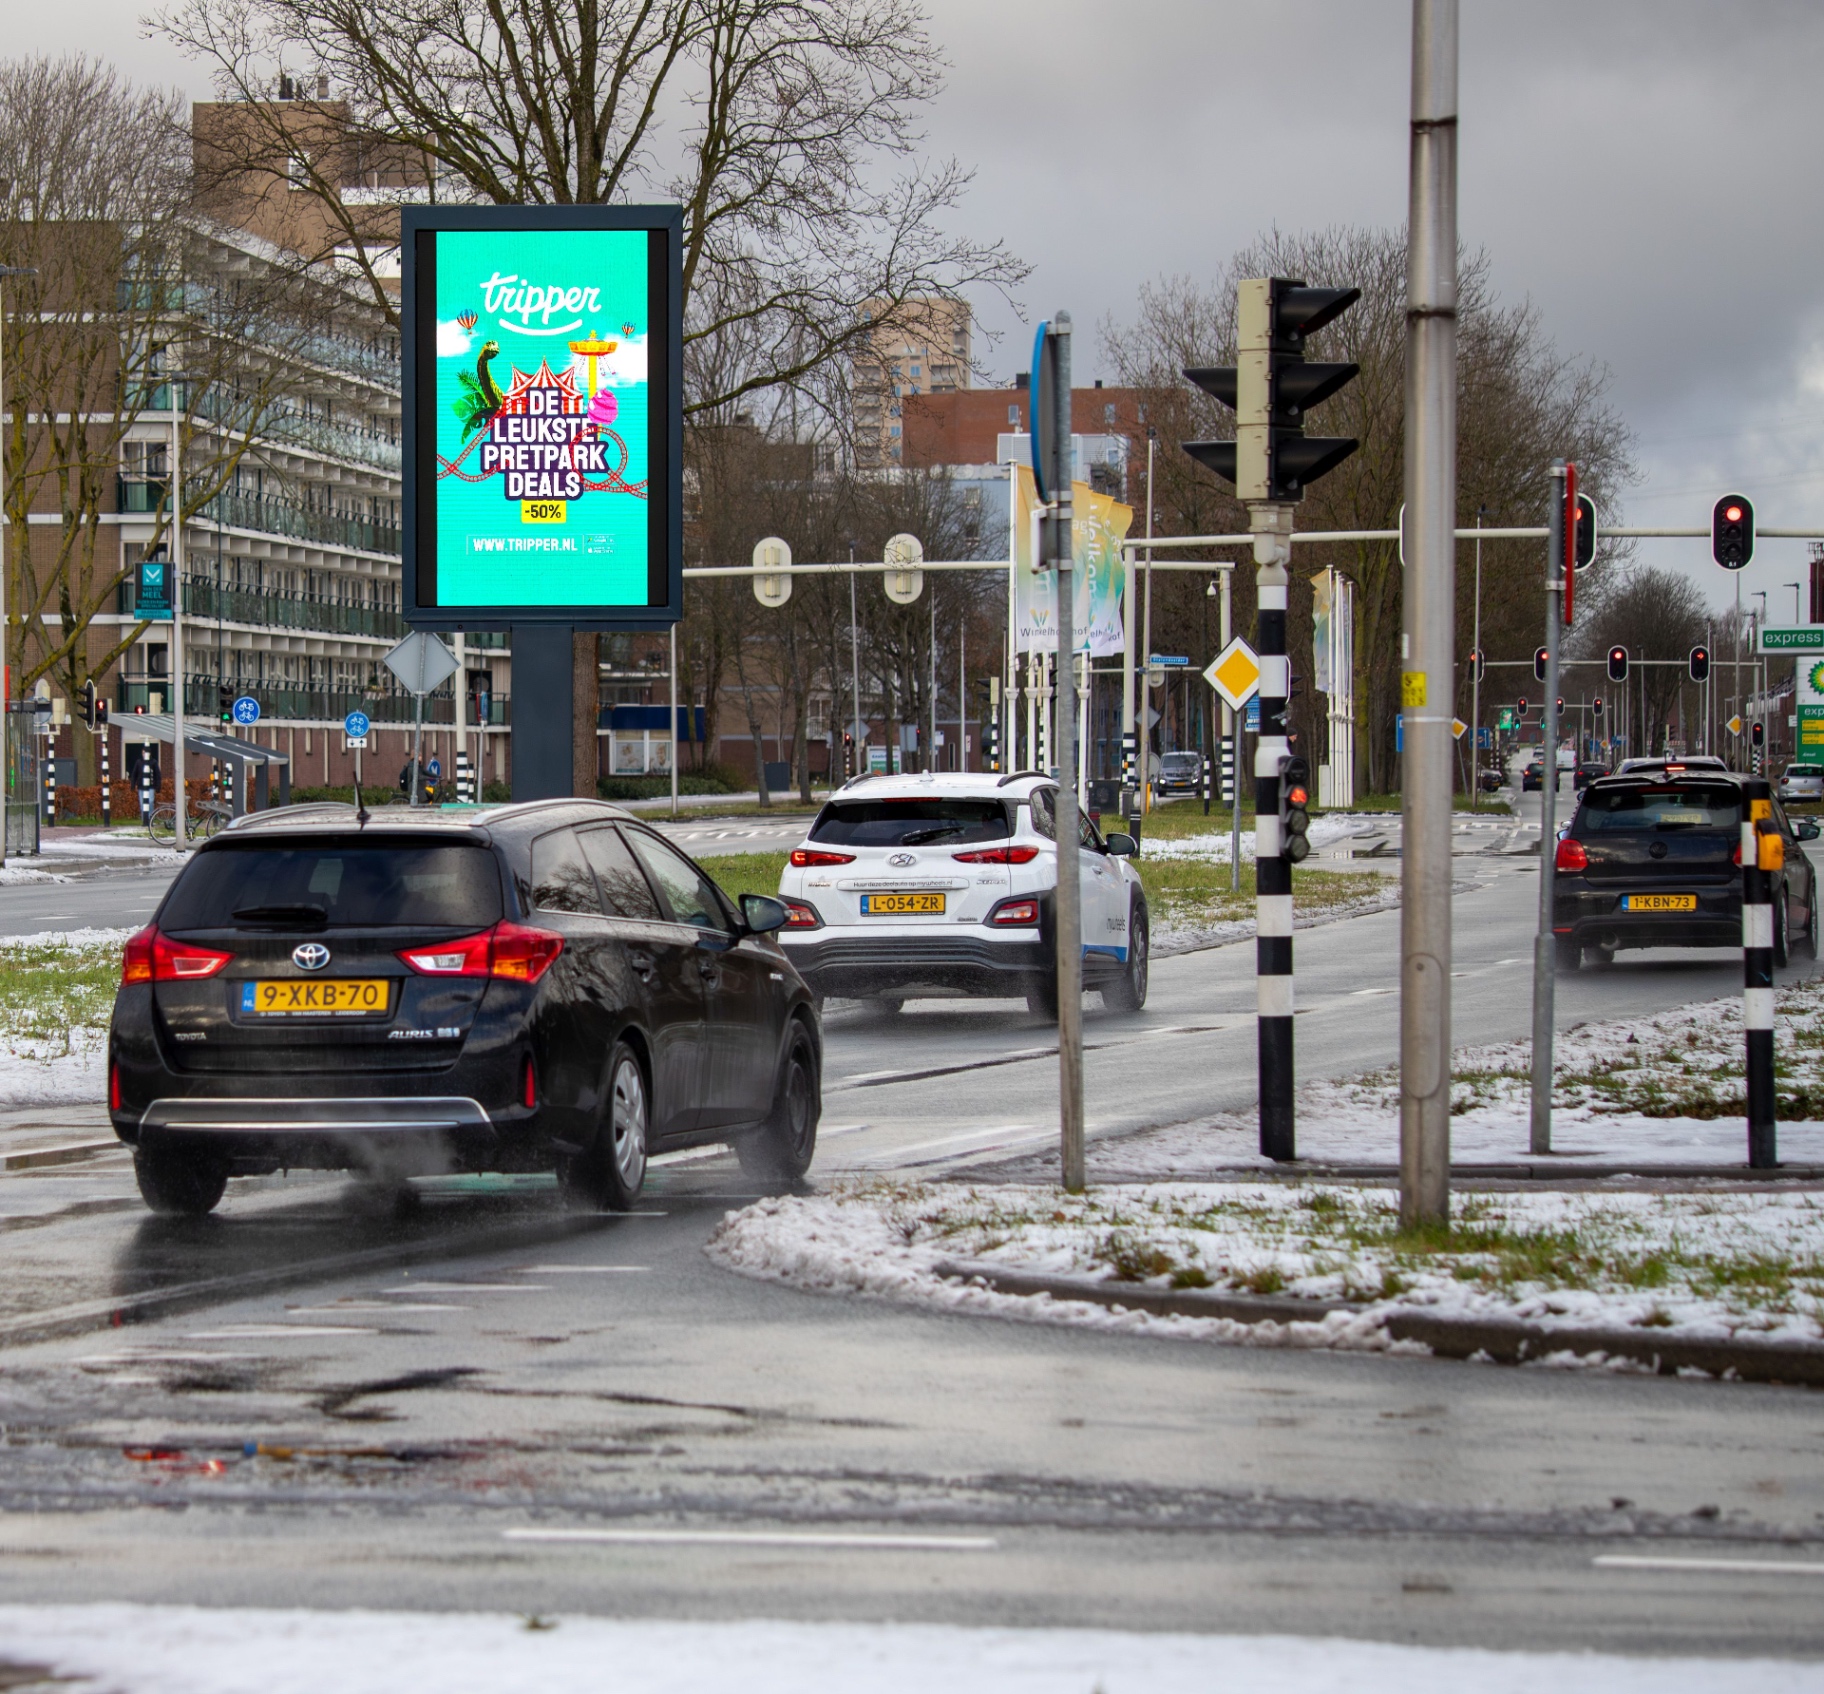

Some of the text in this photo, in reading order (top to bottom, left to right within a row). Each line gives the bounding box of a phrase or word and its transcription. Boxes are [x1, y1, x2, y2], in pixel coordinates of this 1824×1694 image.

[479, 271, 602, 326] tripper
[529, 390, 559, 415] DE
[494, 417, 595, 443] LEUKSTE
[484, 444, 606, 470] PRETPARK
[508, 471, 581, 497] DEALS
[524, 504, 562, 519] -50%
[472, 537, 578, 552] WWW.TRIPPER.NL
[142, 591, 163, 599] MEEL
[1765, 633, 1821, 645] express
[873, 896, 939, 910] L-054-ZR
[1634, 896, 1690, 908] 1-KBN-73
[263, 984, 378, 1007] 9-XKB-70
[175, 1033, 207, 1041] TOYOTA
[388, 1030, 433, 1039] AURIS
